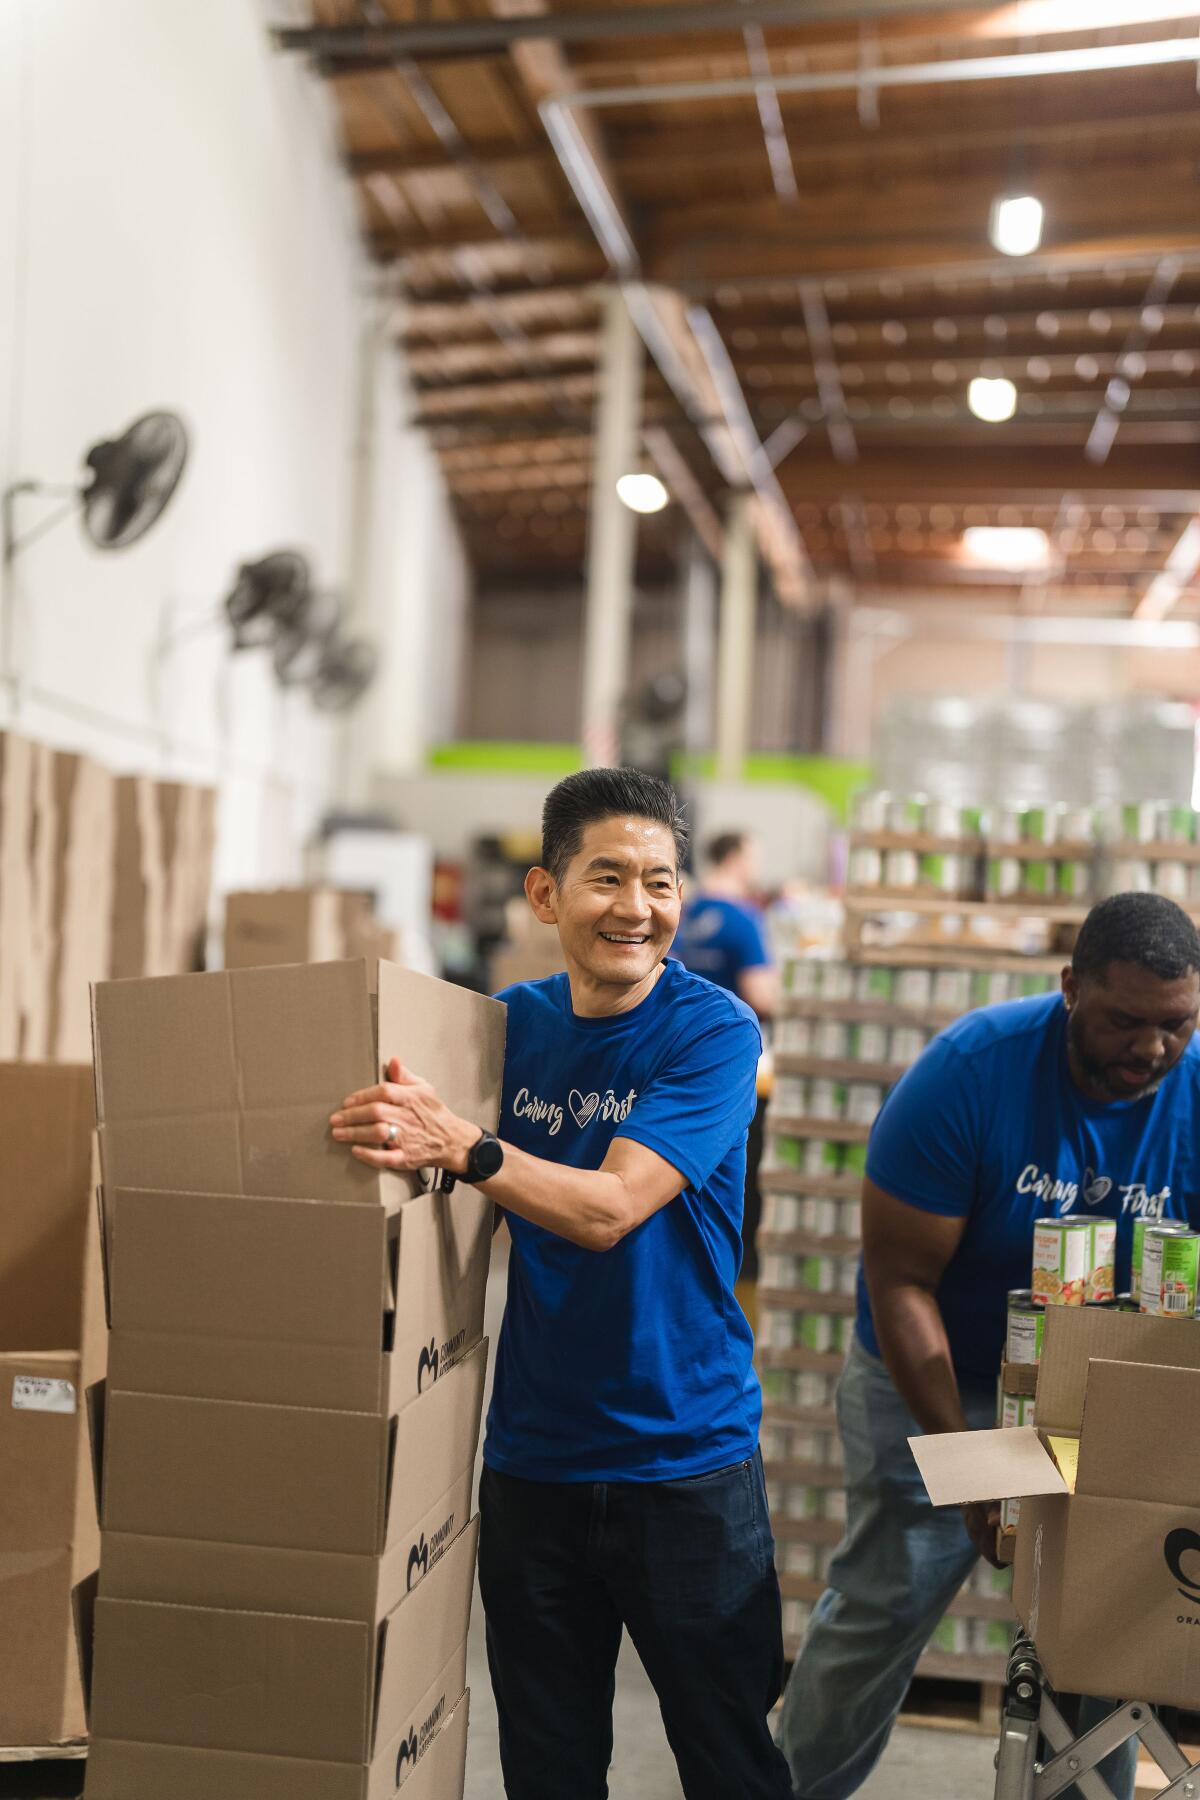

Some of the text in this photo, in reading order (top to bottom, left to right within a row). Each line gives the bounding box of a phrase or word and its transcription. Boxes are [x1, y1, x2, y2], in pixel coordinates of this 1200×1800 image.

[513, 1087, 638, 1136] Caring First
[1016, 1163, 1172, 1224] Caring First
